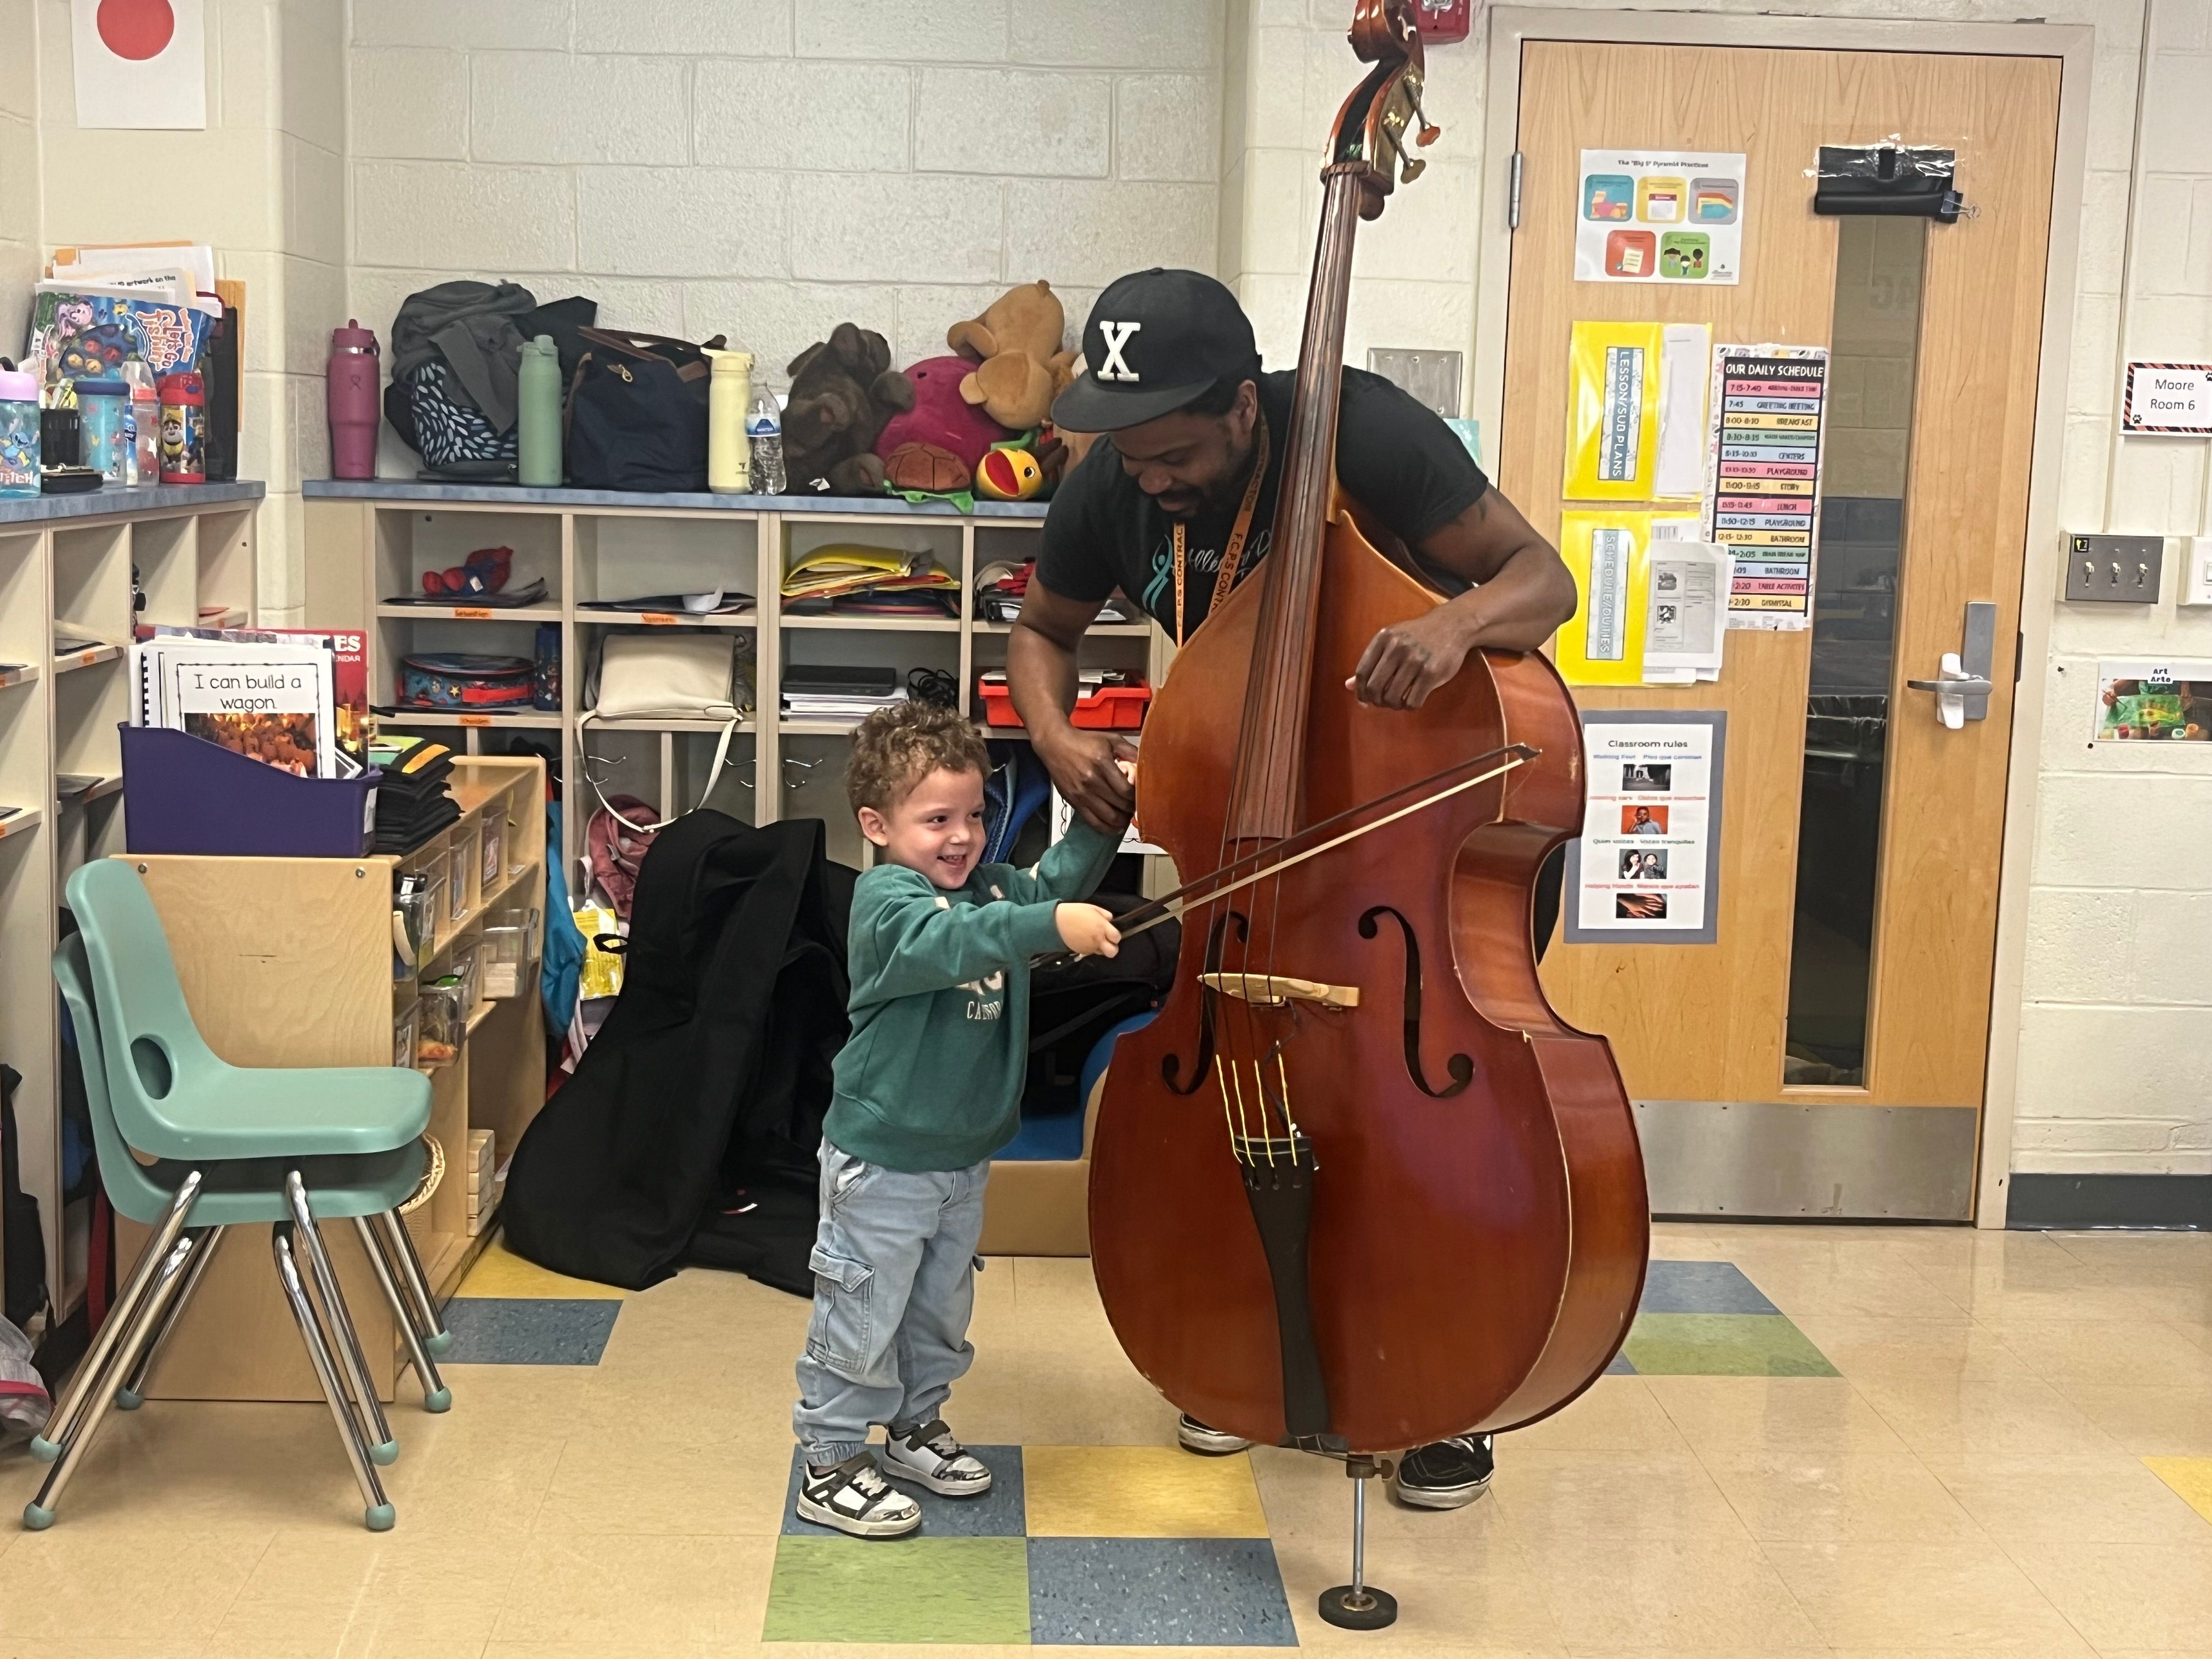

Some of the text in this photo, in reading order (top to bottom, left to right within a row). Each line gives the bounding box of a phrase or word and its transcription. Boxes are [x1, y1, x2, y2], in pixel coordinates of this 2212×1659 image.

[1097, 320, 1141, 382] X
[1726, 364, 1824, 377] OUR DAILY SCHEDULE
[2155, 379, 2194, 391] Moore
[2151, 399, 2195, 410] Room 6
[1612, 351, 1629, 477] LESSON/SUB PLANS
[1600, 535, 1616, 653] SCHEDULE/DUTIES
[194, 674, 301, 689] I can build a
[220, 698, 277, 713] wagon
